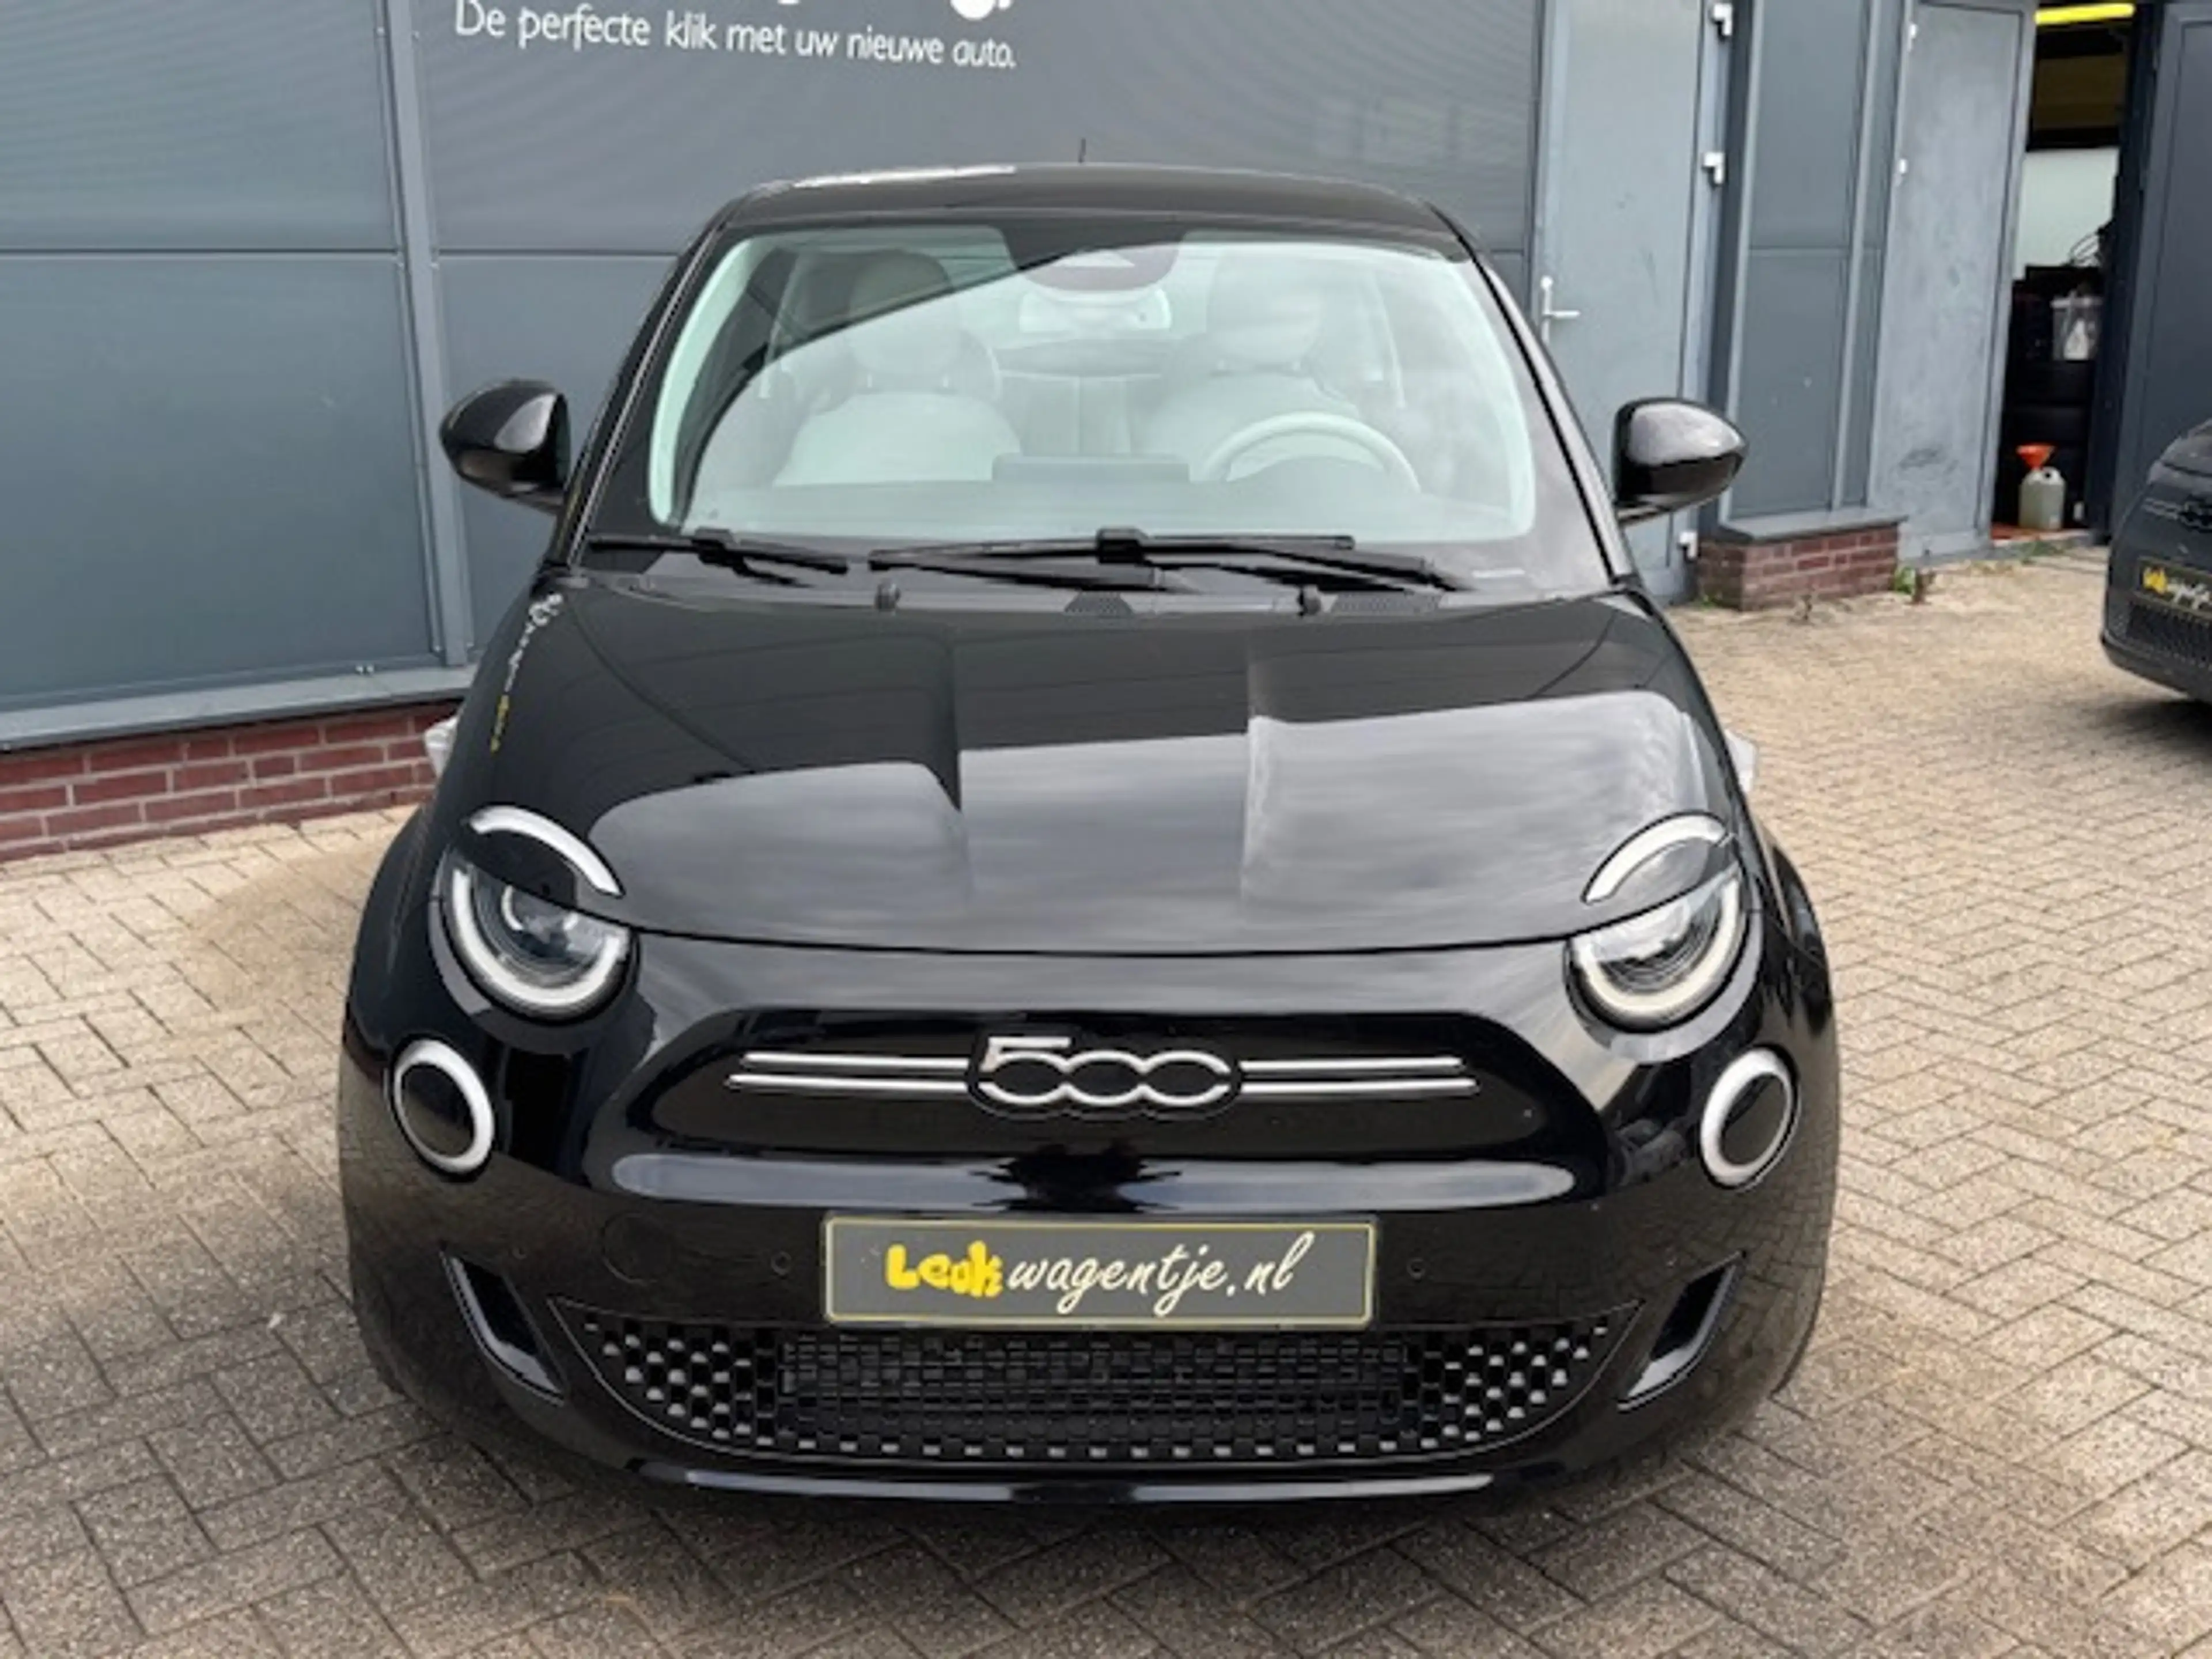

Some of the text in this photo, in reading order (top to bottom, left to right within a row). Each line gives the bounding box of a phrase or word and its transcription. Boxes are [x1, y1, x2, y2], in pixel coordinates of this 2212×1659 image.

[456, 0, 1017, 69] De perfecte klik met uw nieuwe auto.
[979, 1036, 1231, 1107] 500
